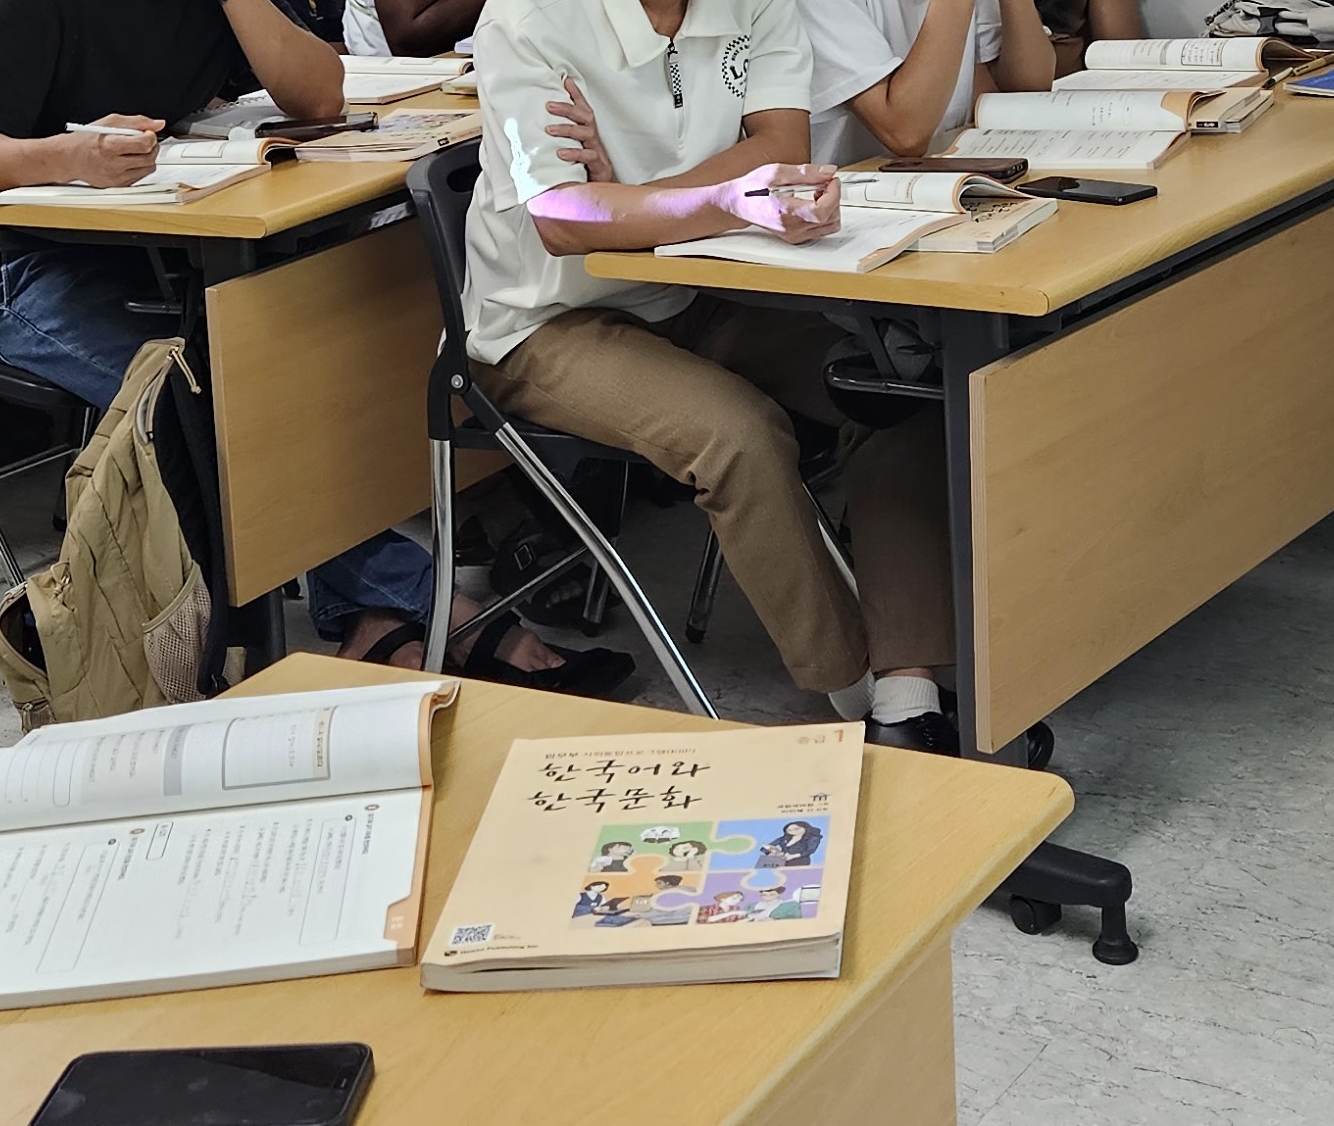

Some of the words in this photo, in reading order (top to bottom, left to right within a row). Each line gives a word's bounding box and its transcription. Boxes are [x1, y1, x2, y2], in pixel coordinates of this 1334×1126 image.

[834, 728, 844, 743] 1
[538, 758, 711, 784] 한국어와
[528, 785, 704, 814] 한국문화
